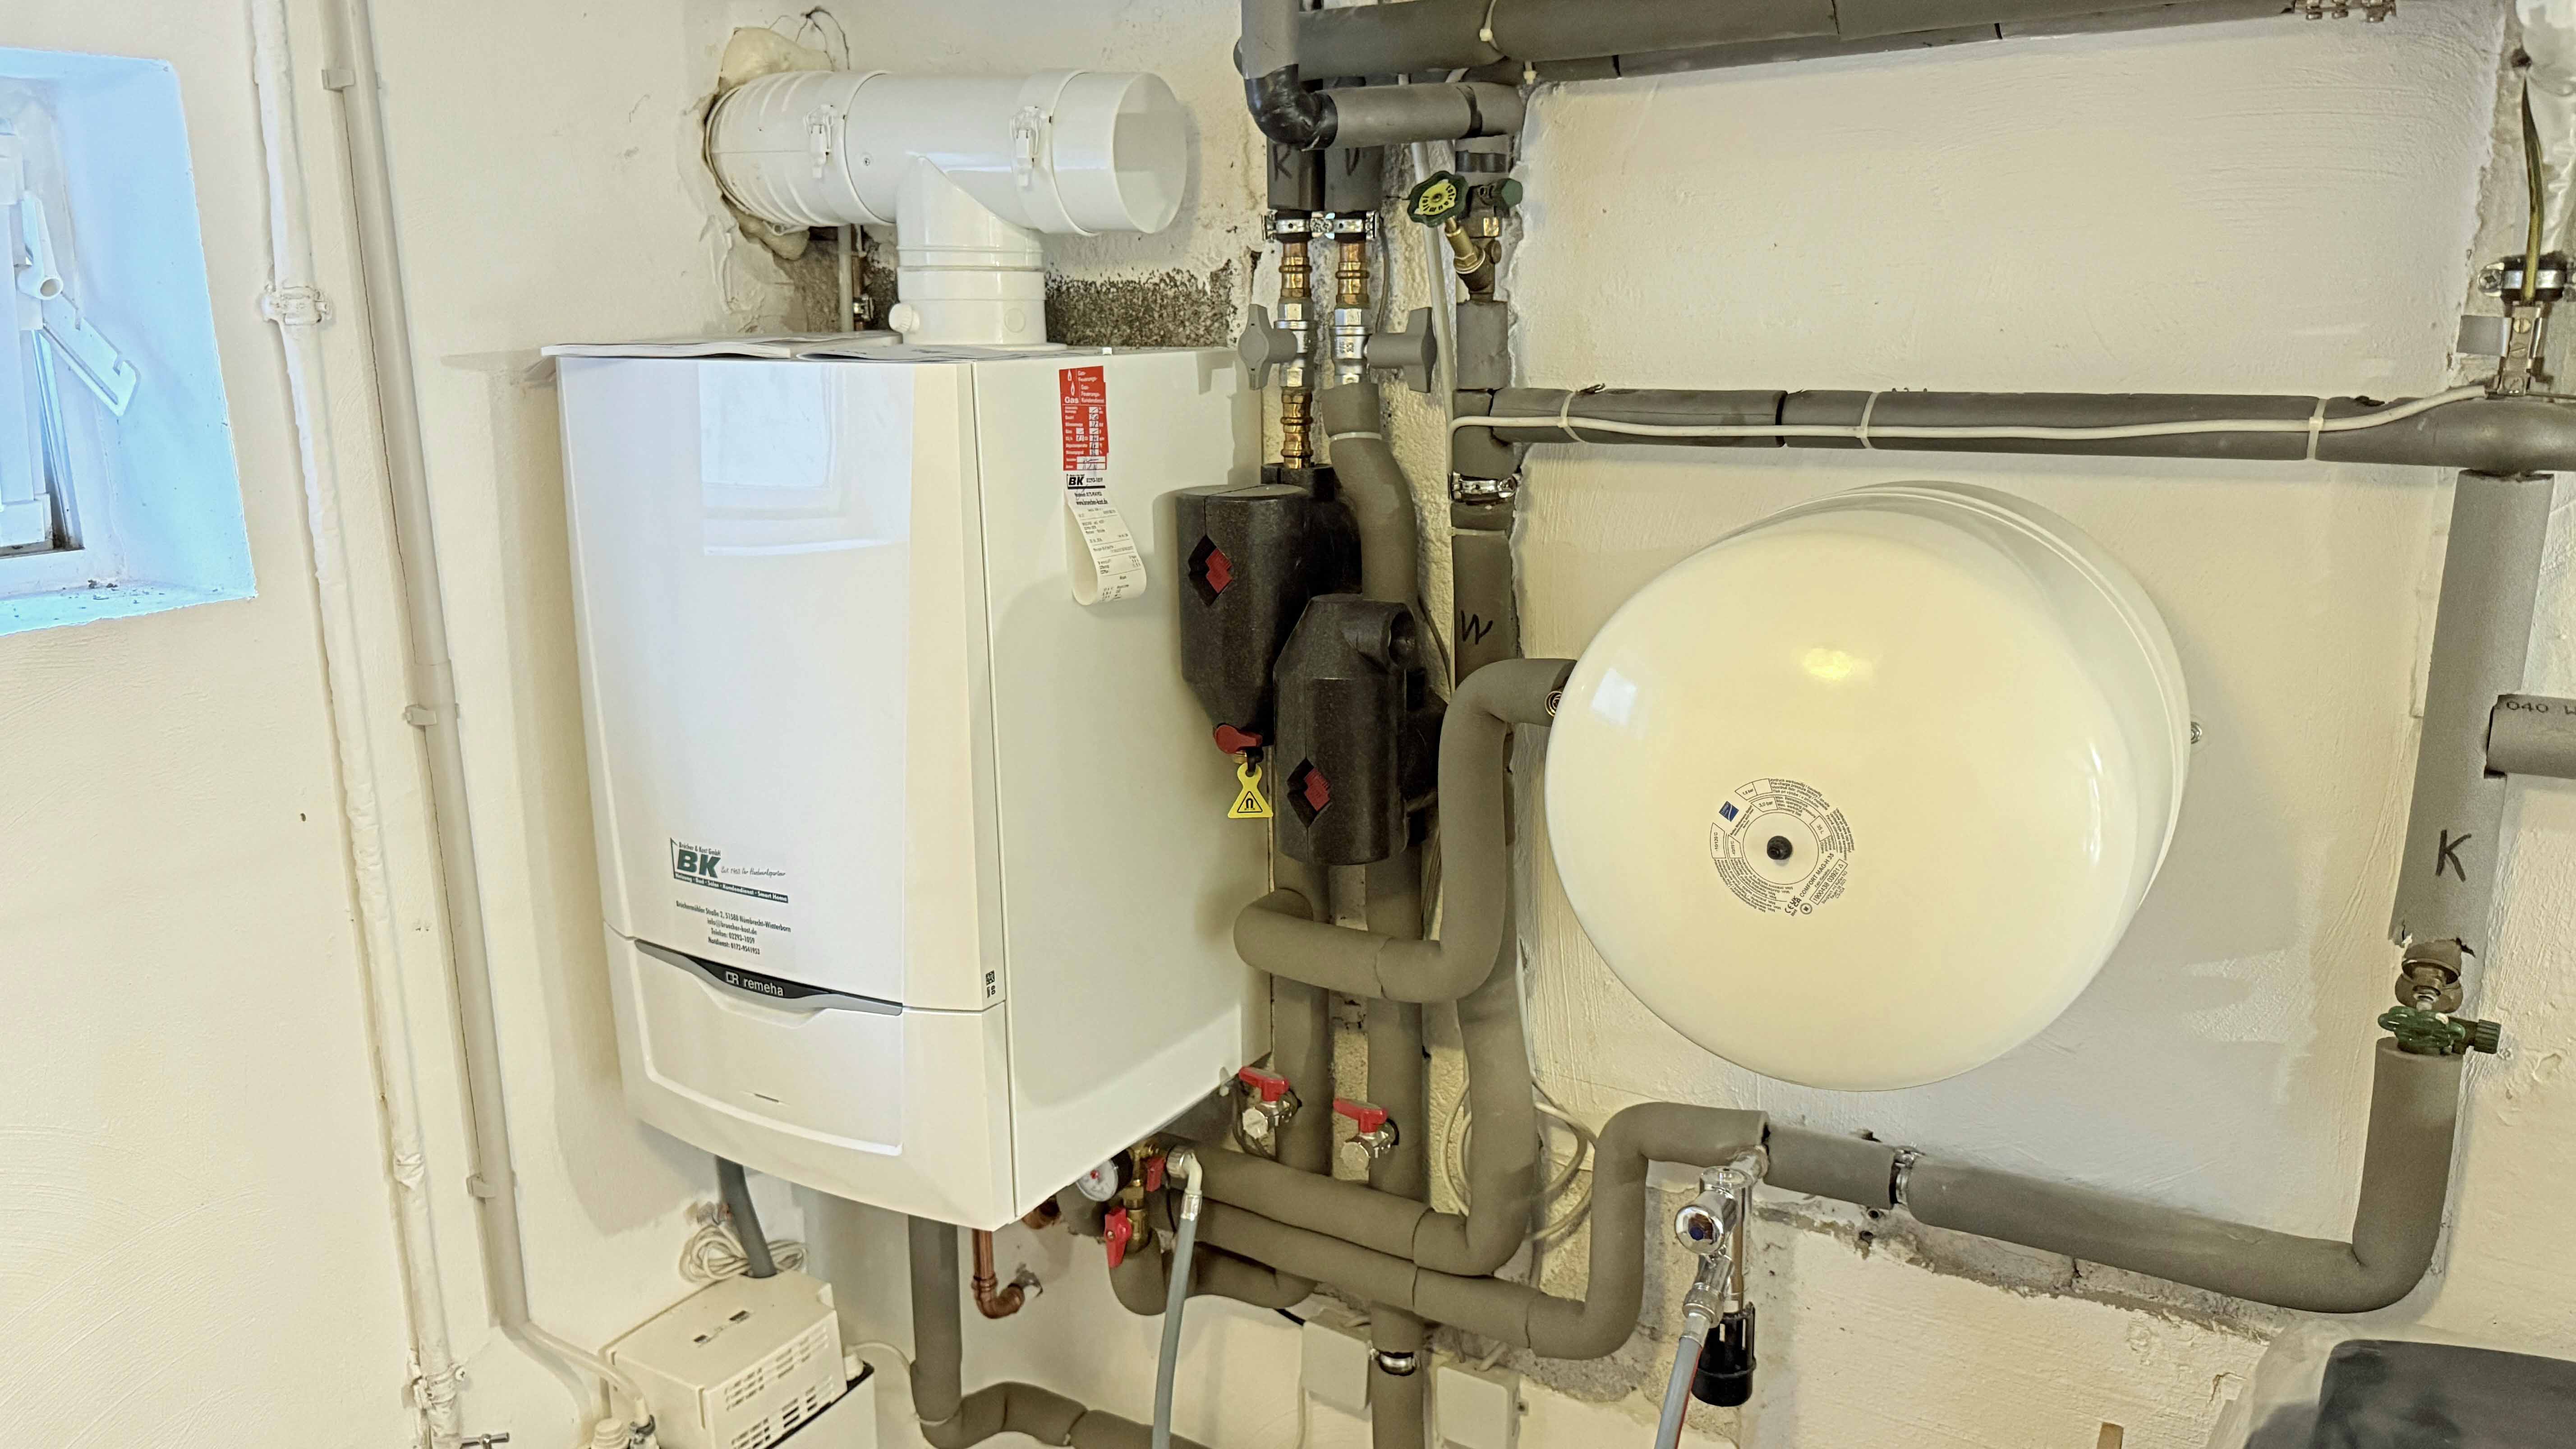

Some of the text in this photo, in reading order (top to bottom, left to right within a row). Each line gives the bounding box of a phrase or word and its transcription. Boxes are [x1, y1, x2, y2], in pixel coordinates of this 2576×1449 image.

[1065, 396, 1079, 404] Gas
[1069, 476, 1084, 485] BK
[1460, 609, 1494, 645] W
[708, 848, 721, 856] GmbH
[2436, 829, 2472, 883] K
[677, 849, 722, 879] BK
[1799, 874, 1818, 898] COMFORT
[1815, 858, 1830, 876] MAG-H
[1826, 851, 1835, 861] 35
[1812, 881, 1830, 902] 1900438
[743, 979, 784, 996] remeha
